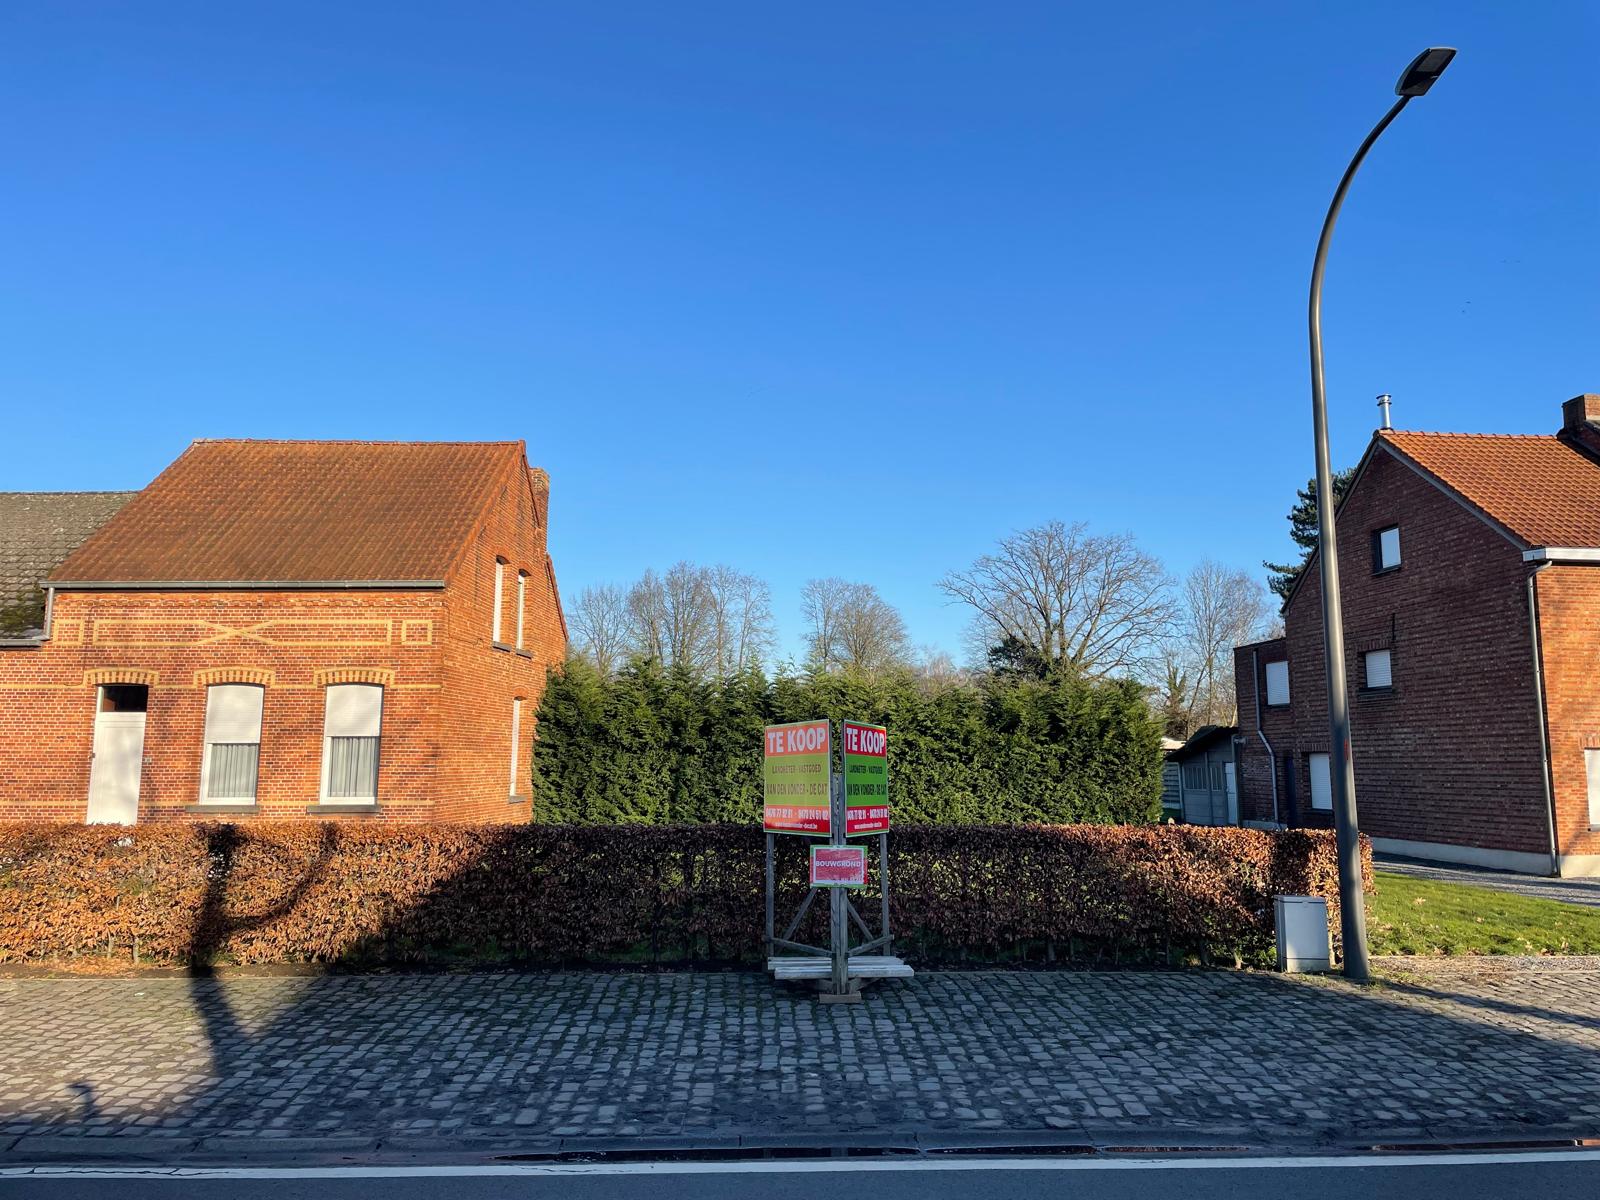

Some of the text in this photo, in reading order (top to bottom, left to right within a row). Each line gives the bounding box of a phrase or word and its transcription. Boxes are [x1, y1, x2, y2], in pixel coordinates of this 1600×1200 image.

[768, 728, 826, 753] TE KOOP
[846, 728, 885, 753] TE KOOP
[815, 860, 861, 868] BOUWGROND
